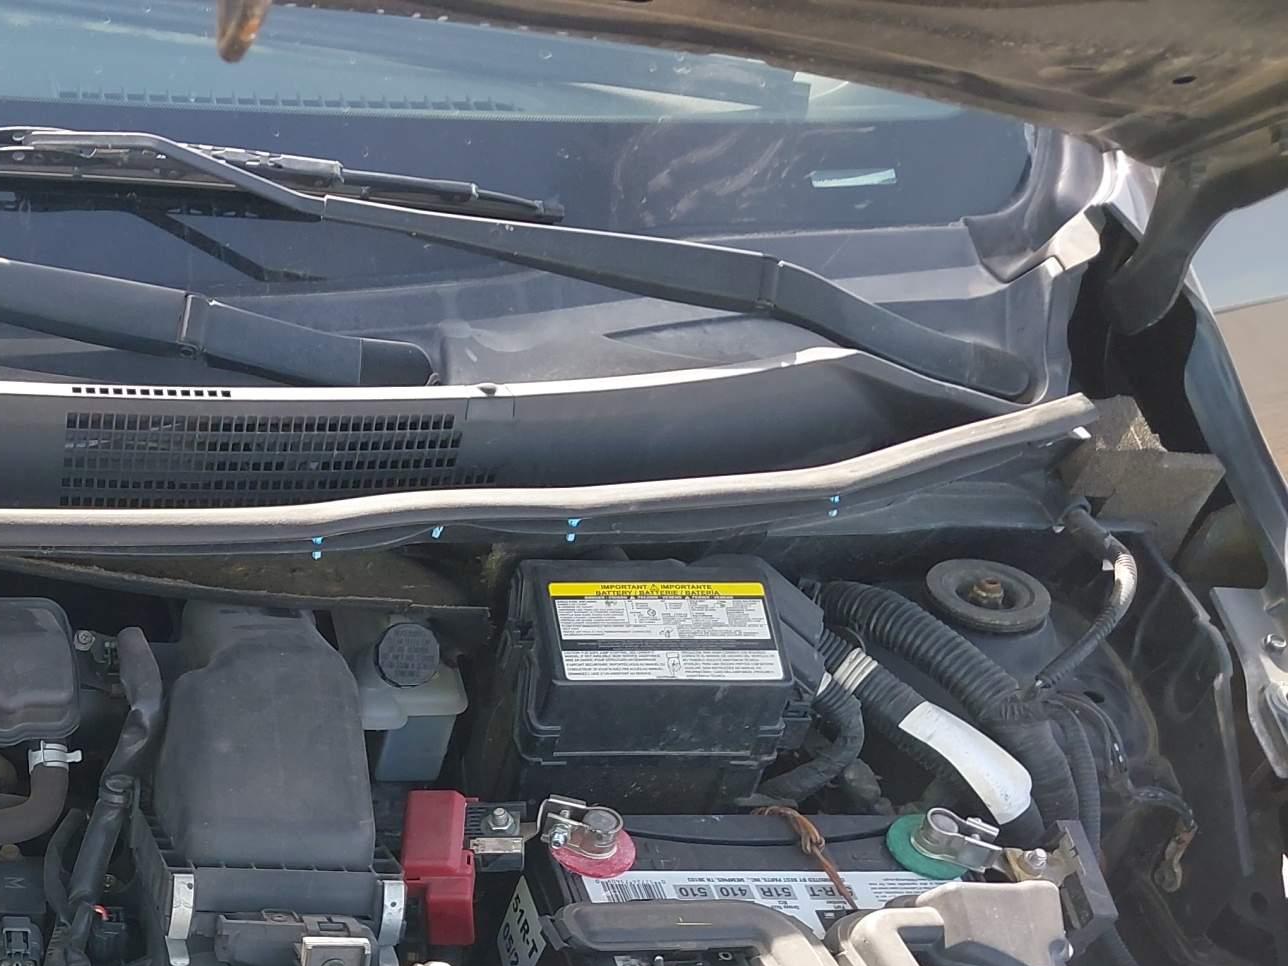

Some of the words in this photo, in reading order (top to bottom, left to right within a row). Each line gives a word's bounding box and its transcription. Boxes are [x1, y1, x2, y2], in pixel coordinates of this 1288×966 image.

[678, 886, 708, 898] 510
[719, 886, 748, 898] 410
[760, 886, 792, 898] 51R
[809, 886, 854, 898] 5R-T
[511, 894, 539, 959] 51R-T
